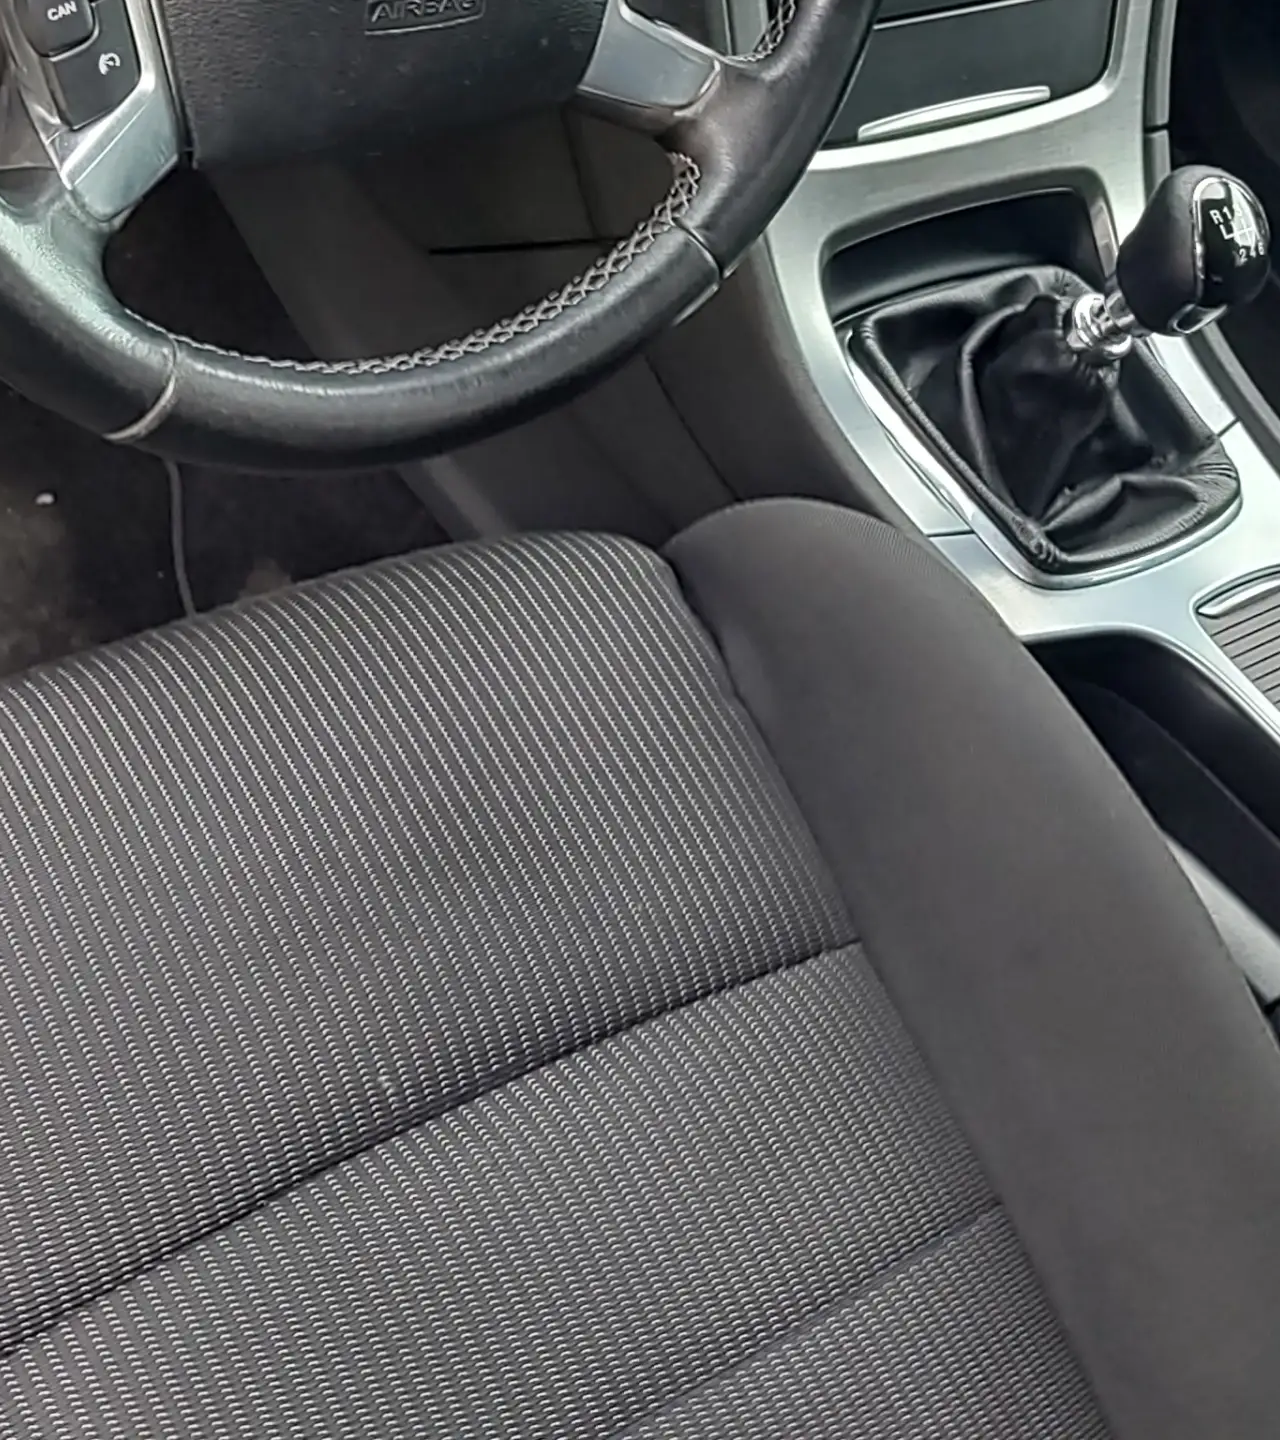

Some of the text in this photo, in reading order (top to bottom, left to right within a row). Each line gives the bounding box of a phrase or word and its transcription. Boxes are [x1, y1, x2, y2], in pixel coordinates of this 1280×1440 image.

[47, 1, 78, 21] CAN
[1209, 209, 1224, 225] R
[1221, 205, 1232, 220] 1
